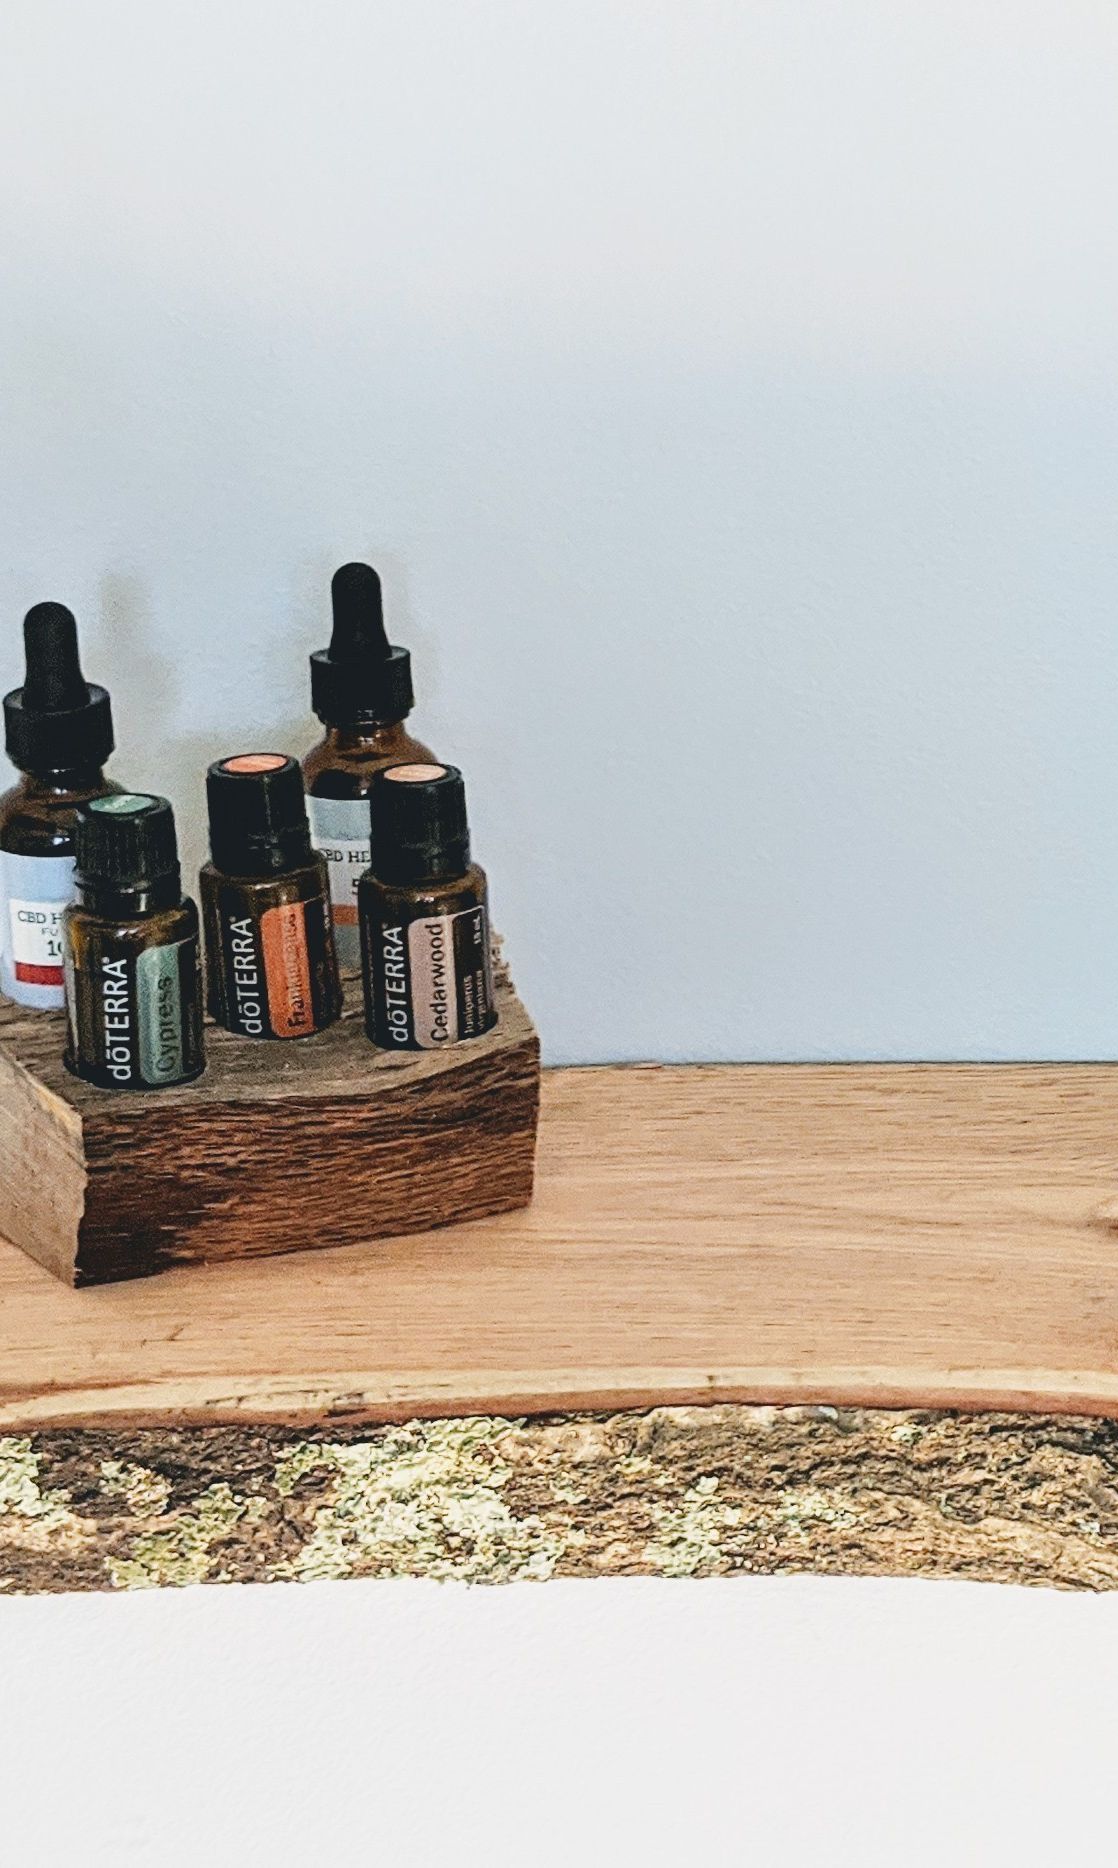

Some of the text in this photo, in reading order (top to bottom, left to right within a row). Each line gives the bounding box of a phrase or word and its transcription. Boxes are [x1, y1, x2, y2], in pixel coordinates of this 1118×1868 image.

[17, 910, 47, 925] CBD
[155, 975, 180, 1072] Cypress
[425, 923, 449, 1042] Cedarwood
